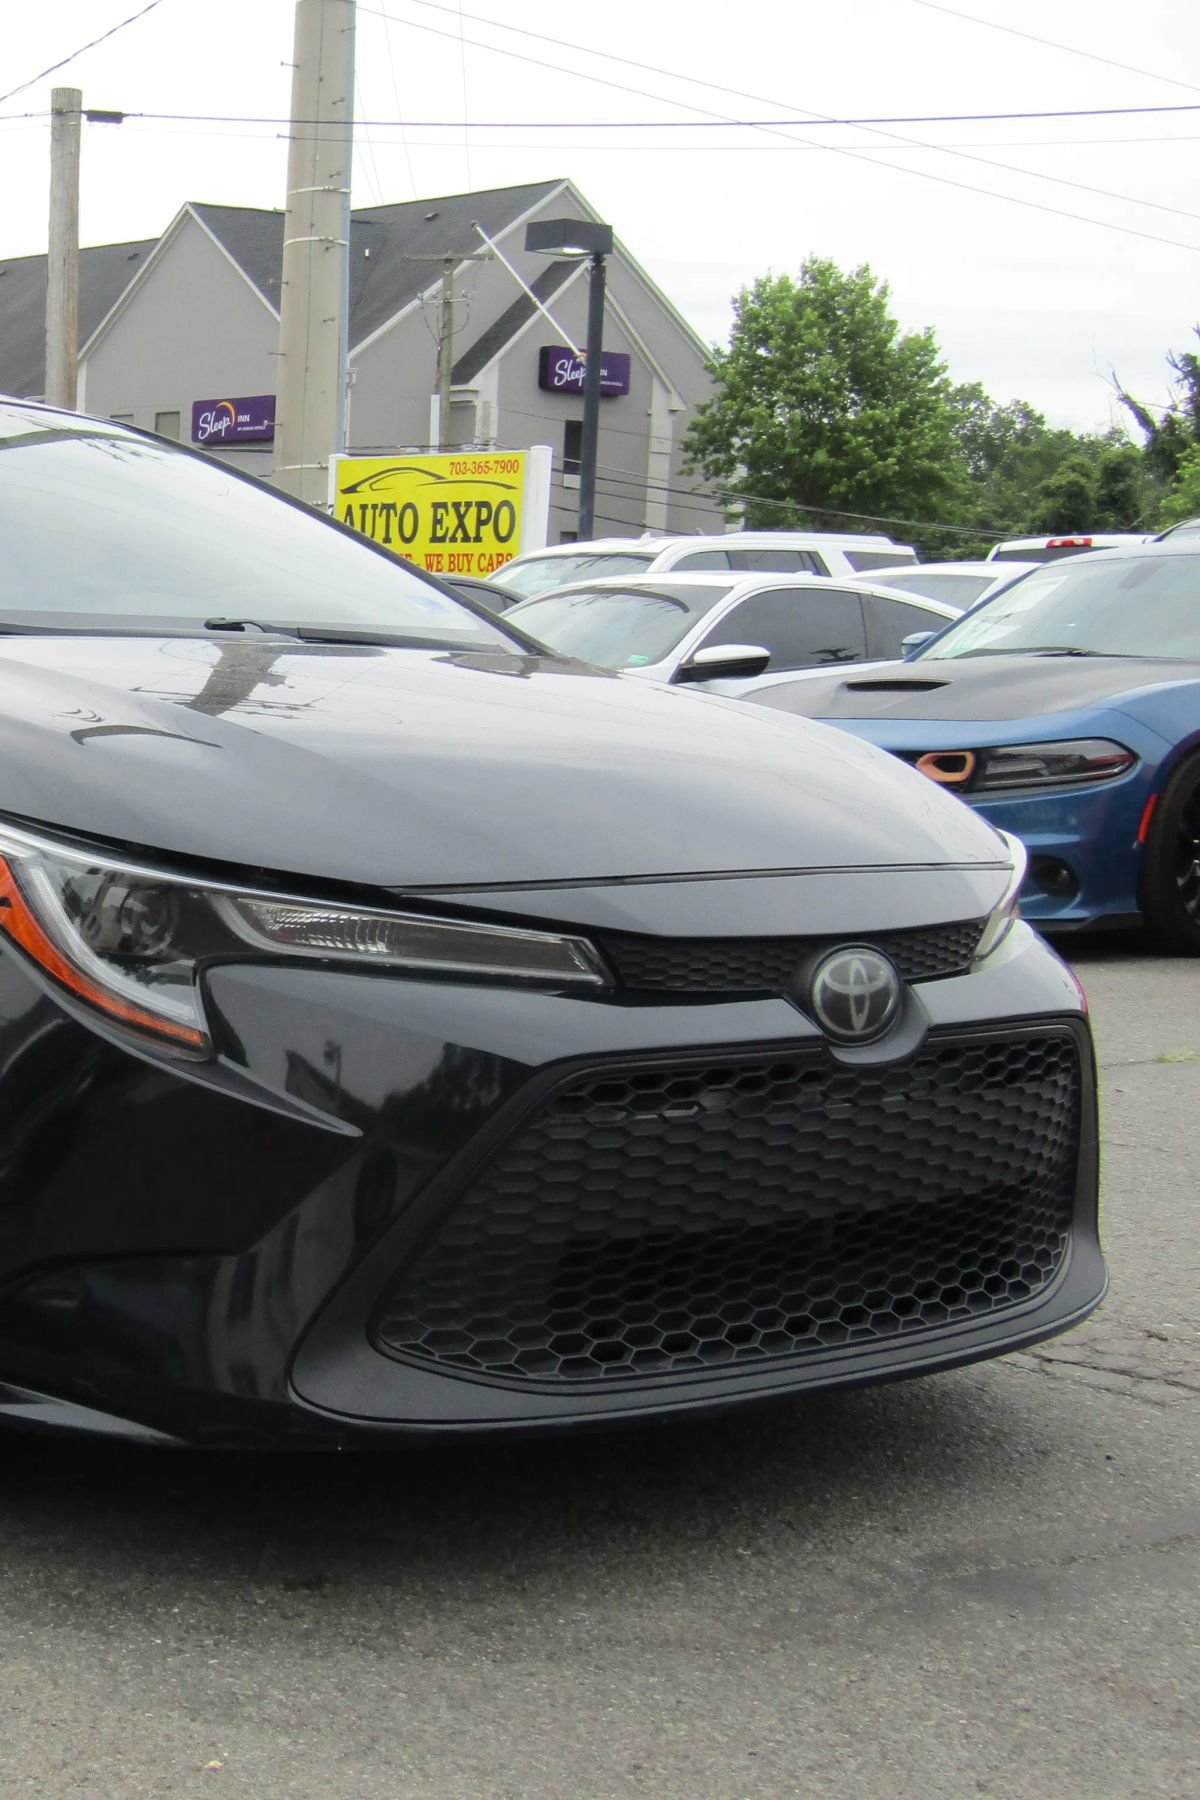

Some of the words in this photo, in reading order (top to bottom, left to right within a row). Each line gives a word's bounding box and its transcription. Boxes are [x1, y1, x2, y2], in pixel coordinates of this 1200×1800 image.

[198, 411, 231, 440] Sleep
[237, 414, 250, 423] INN
[449, 459, 520, 475] 703-365-7900
[344, 502, 419, 544] AUTO
[429, 500, 516, 544] EXPO
[425, 553, 443, 572] WE
[448, 553, 474, 572] BUY
